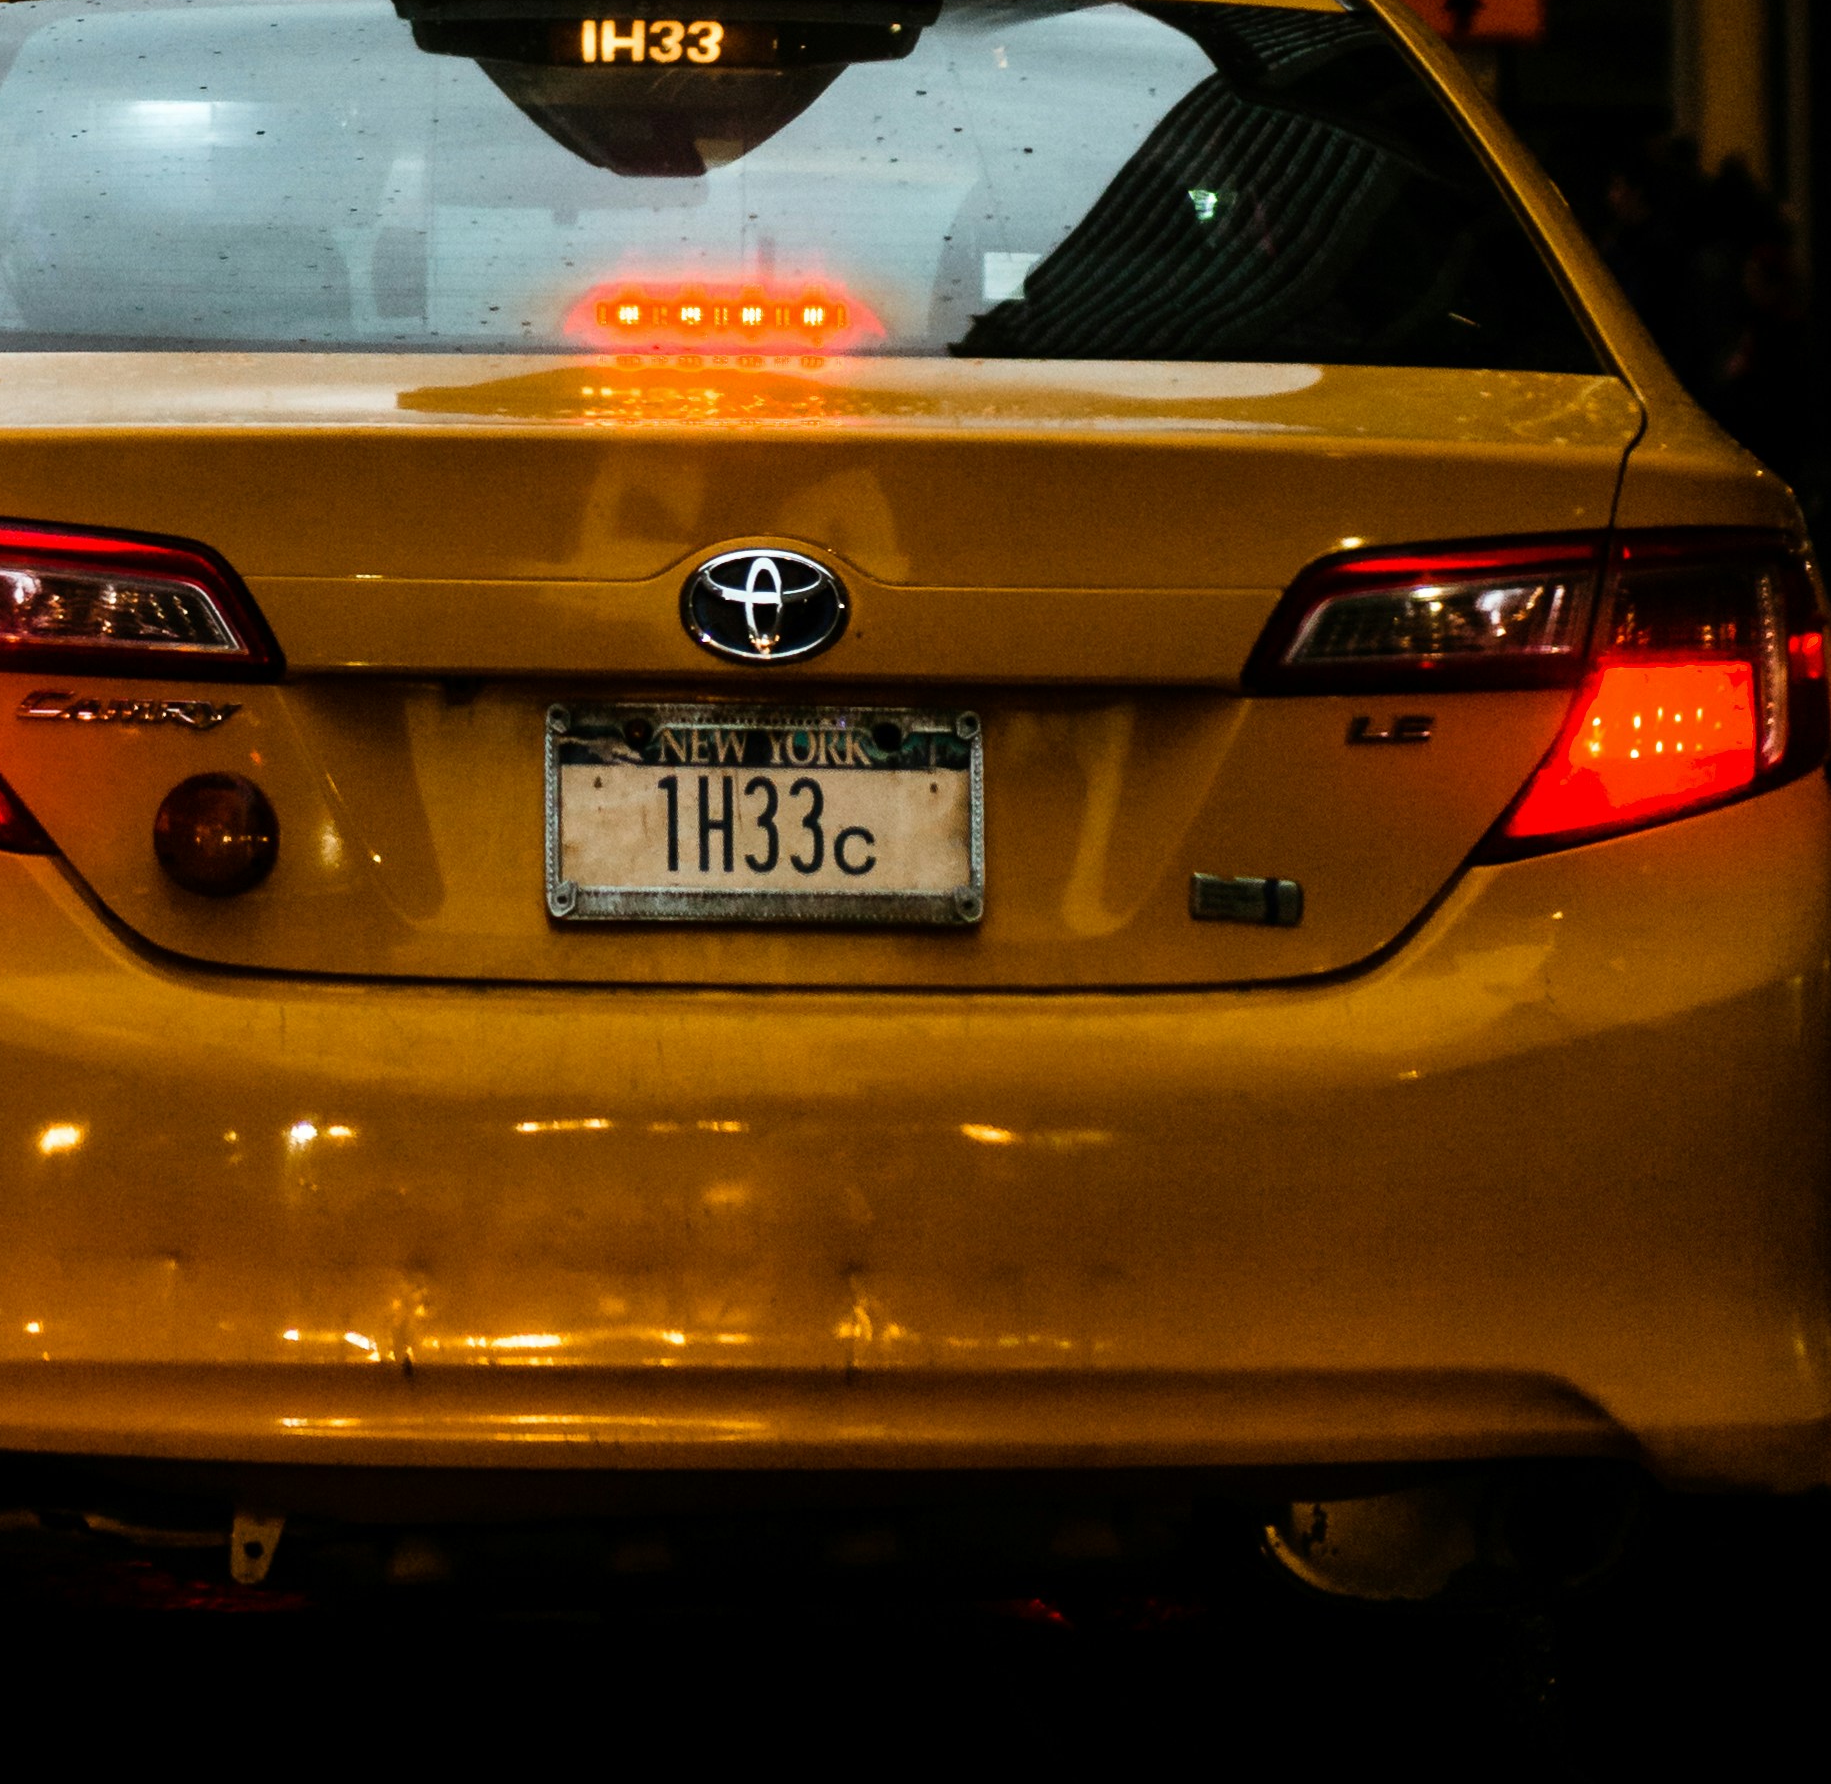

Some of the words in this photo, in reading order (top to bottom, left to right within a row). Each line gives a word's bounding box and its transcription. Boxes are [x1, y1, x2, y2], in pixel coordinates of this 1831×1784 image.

[1346, 716, 1436, 745] LE
[657, 729, 748, 763] NEW
[768, 729, 873, 767] YORK
